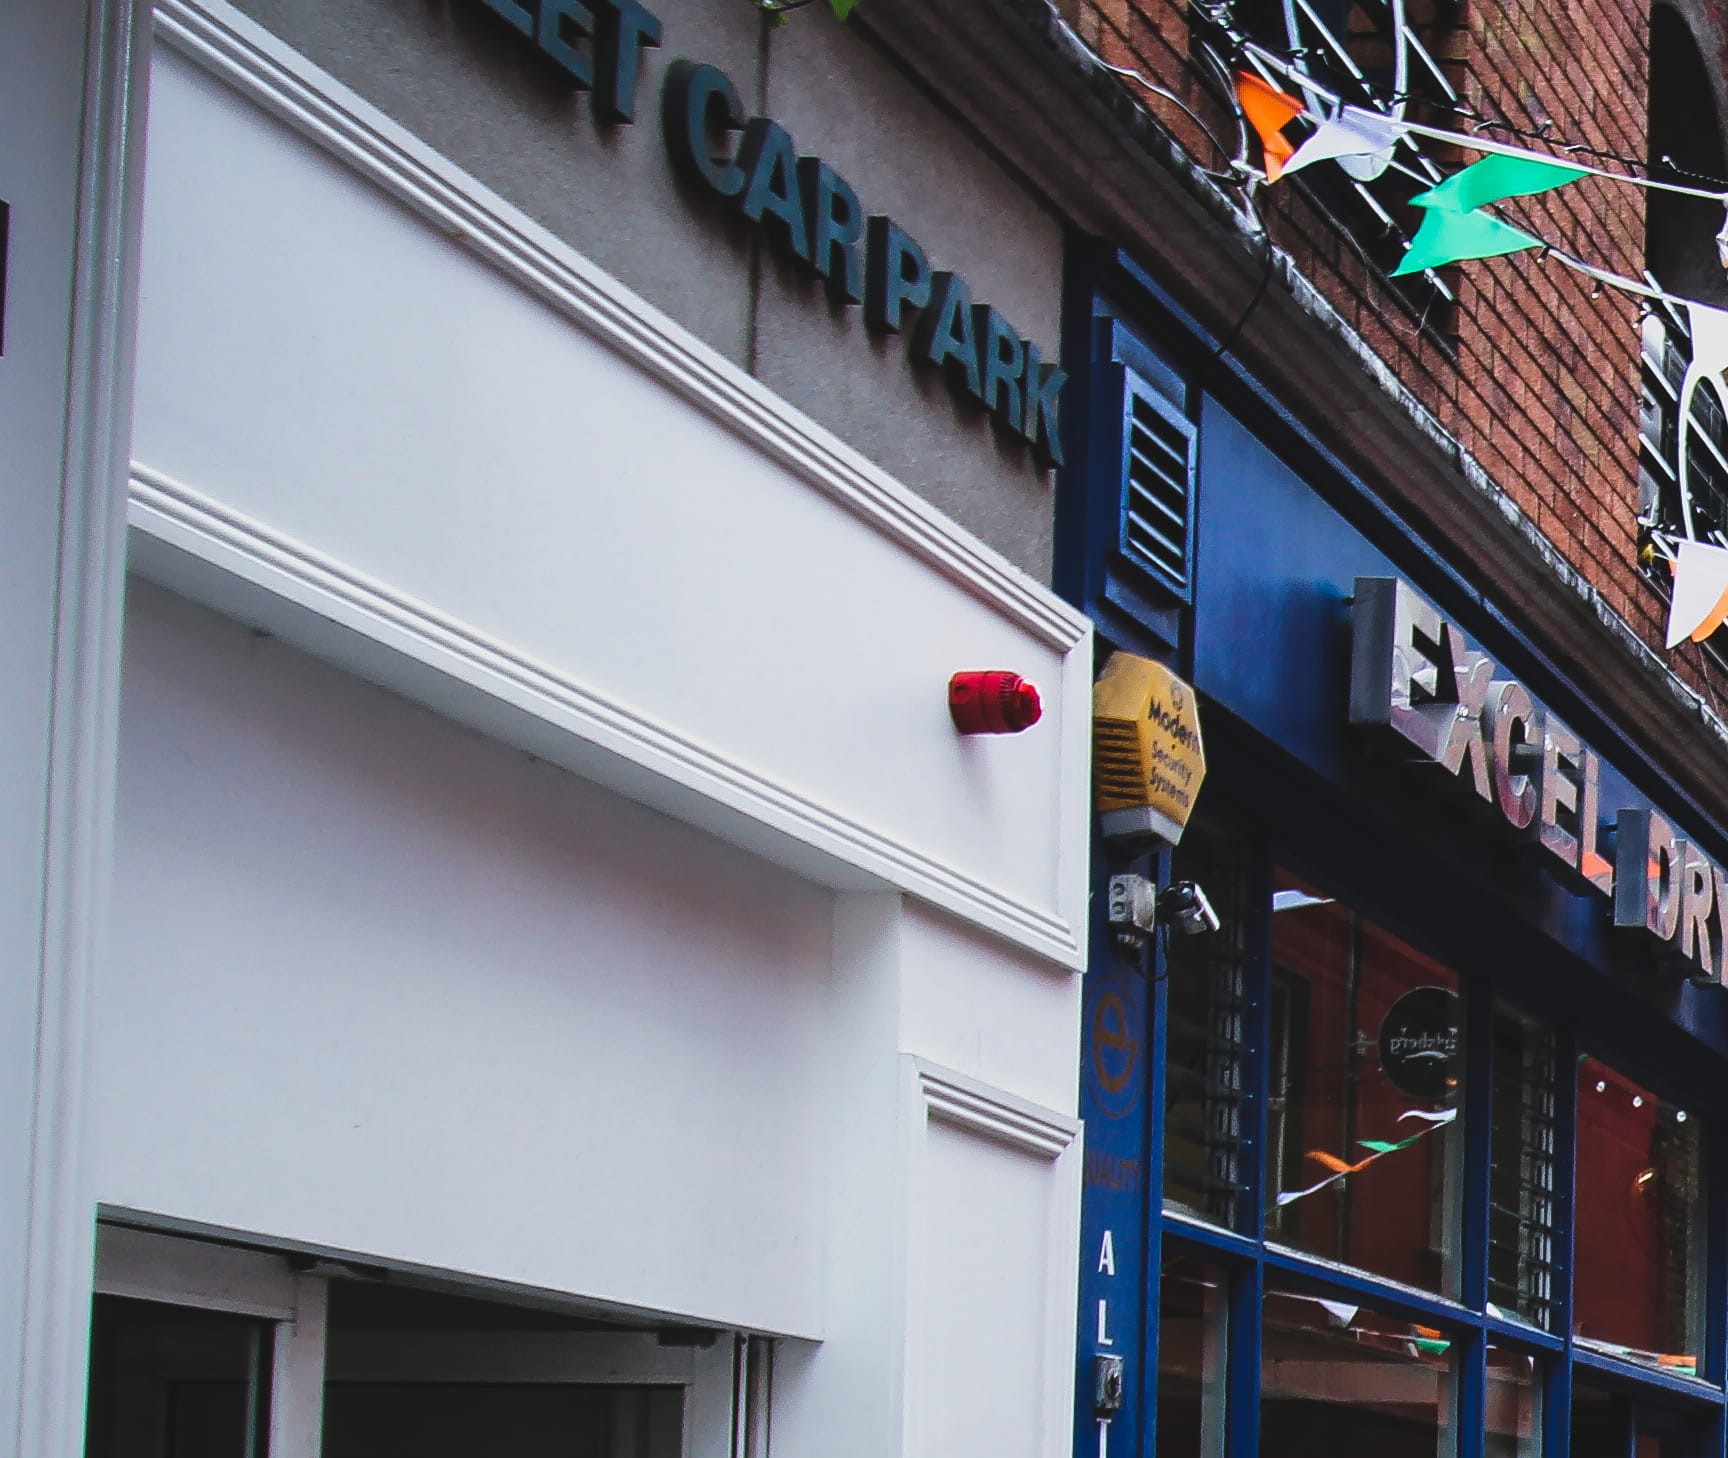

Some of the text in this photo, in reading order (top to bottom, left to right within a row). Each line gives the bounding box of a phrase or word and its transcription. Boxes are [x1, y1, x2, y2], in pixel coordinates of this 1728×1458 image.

[664, 58, 1068, 466] CAR PARK
[1352, 577, 1613, 897] EXCEL
